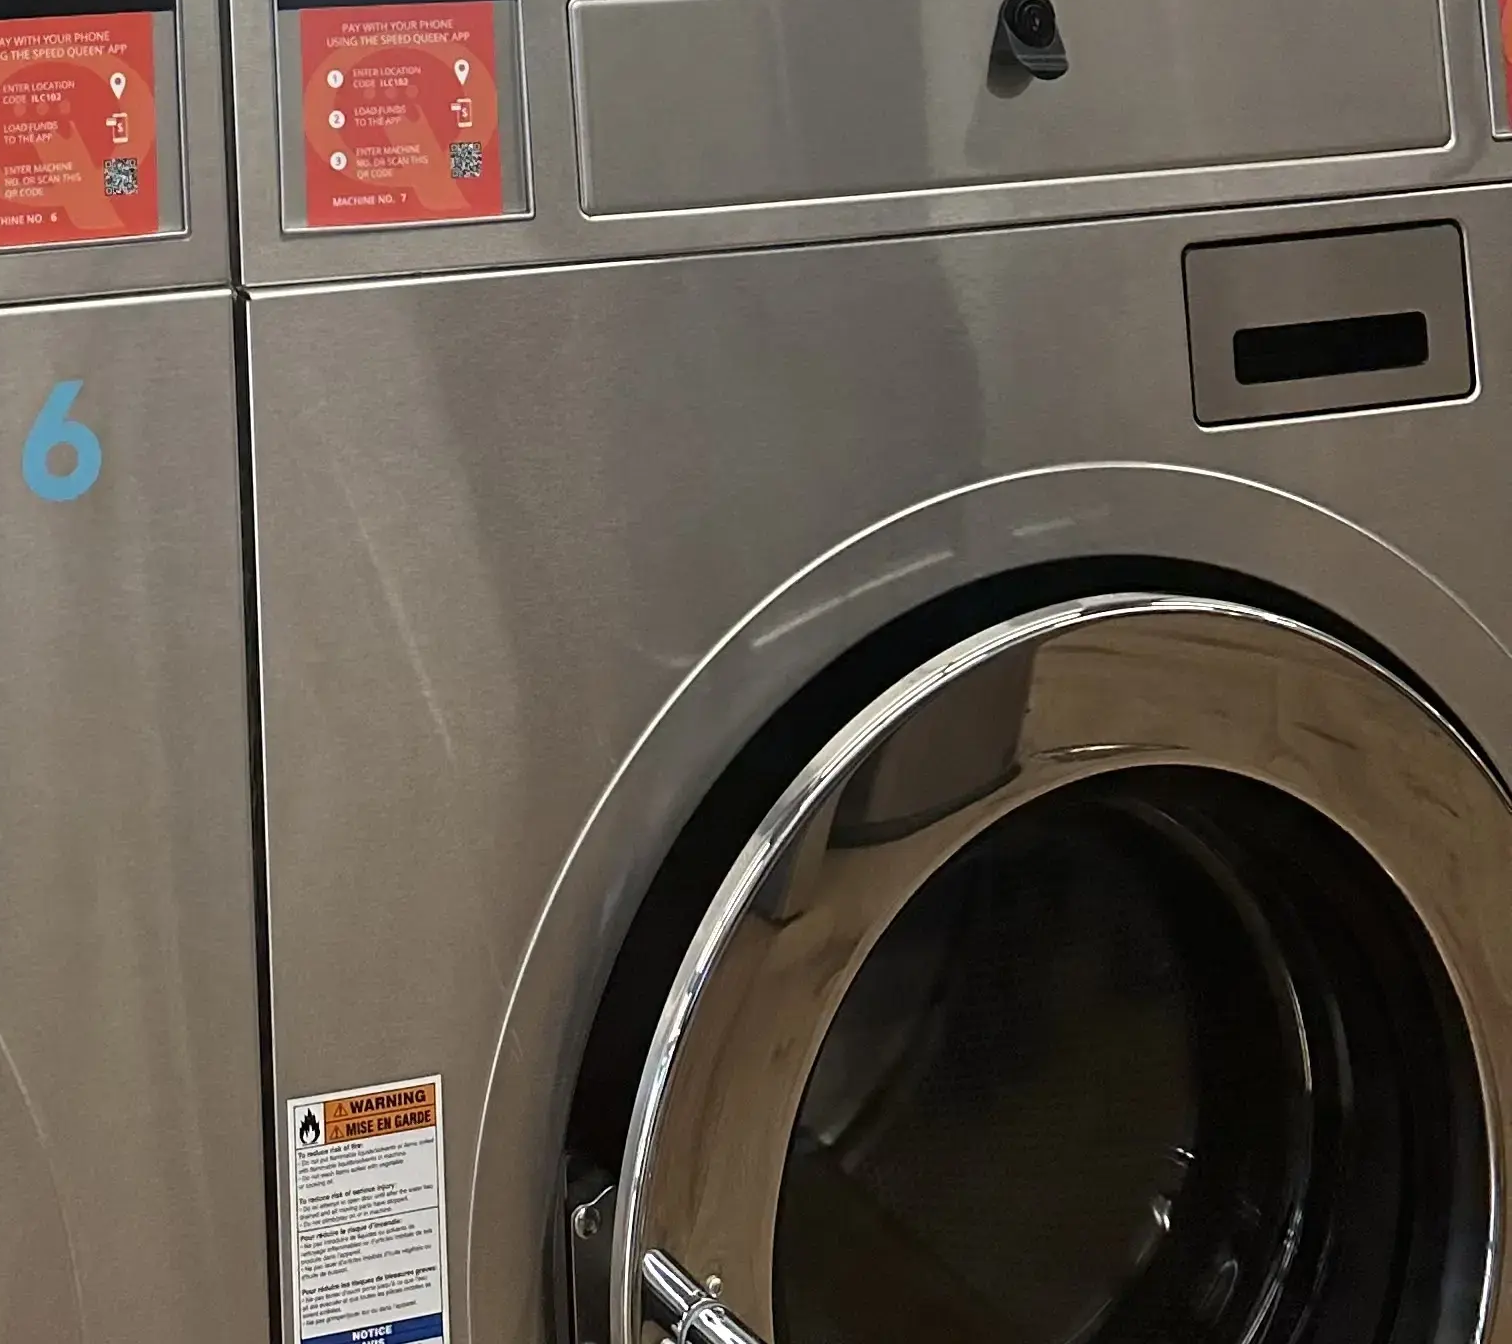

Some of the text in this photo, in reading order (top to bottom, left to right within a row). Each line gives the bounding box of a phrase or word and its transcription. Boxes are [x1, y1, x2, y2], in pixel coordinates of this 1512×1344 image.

[342, 18, 454, 33] PAY WITH YOUR PHONE
[13, 35, 40, 47] WITH
[42, 33, 71, 45] YOUR
[74, 31, 110, 42] PHONE
[326, 36, 358, 48] USING
[359, 34, 378, 46] THE
[381, 33, 411, 45] SPEED
[451, 31, 470, 41] APP
[10, 49, 30, 61] THE
[33, 47, 65, 60] SPEED
[108, 44, 128, 55] APP
[380, 65, 422, 76] LOCATION
[3, 80, 75, 93] ENTER LOCATION
[353, 79, 376, 89] CODE
[3, 94, 27, 105] CODE
[4, 121, 58, 133] LOAD FUNDS
[355, 117, 367, 127] TO
[4, 134, 17, 145] TO
[18, 134, 36, 144] THE
[4, 162, 73, 176] ENTER MACHINE
[332, 194, 376, 207] MACHINE
[400, 193, 407, 203] 7
[50, 213, 58, 223] 6
[21, 379, 102, 502] 6
[350, 1089, 426, 1114] WARNING
[346, 1110, 432, 1136] MISE EN GARDE
[352, 1324, 393, 1341] NOTICE
